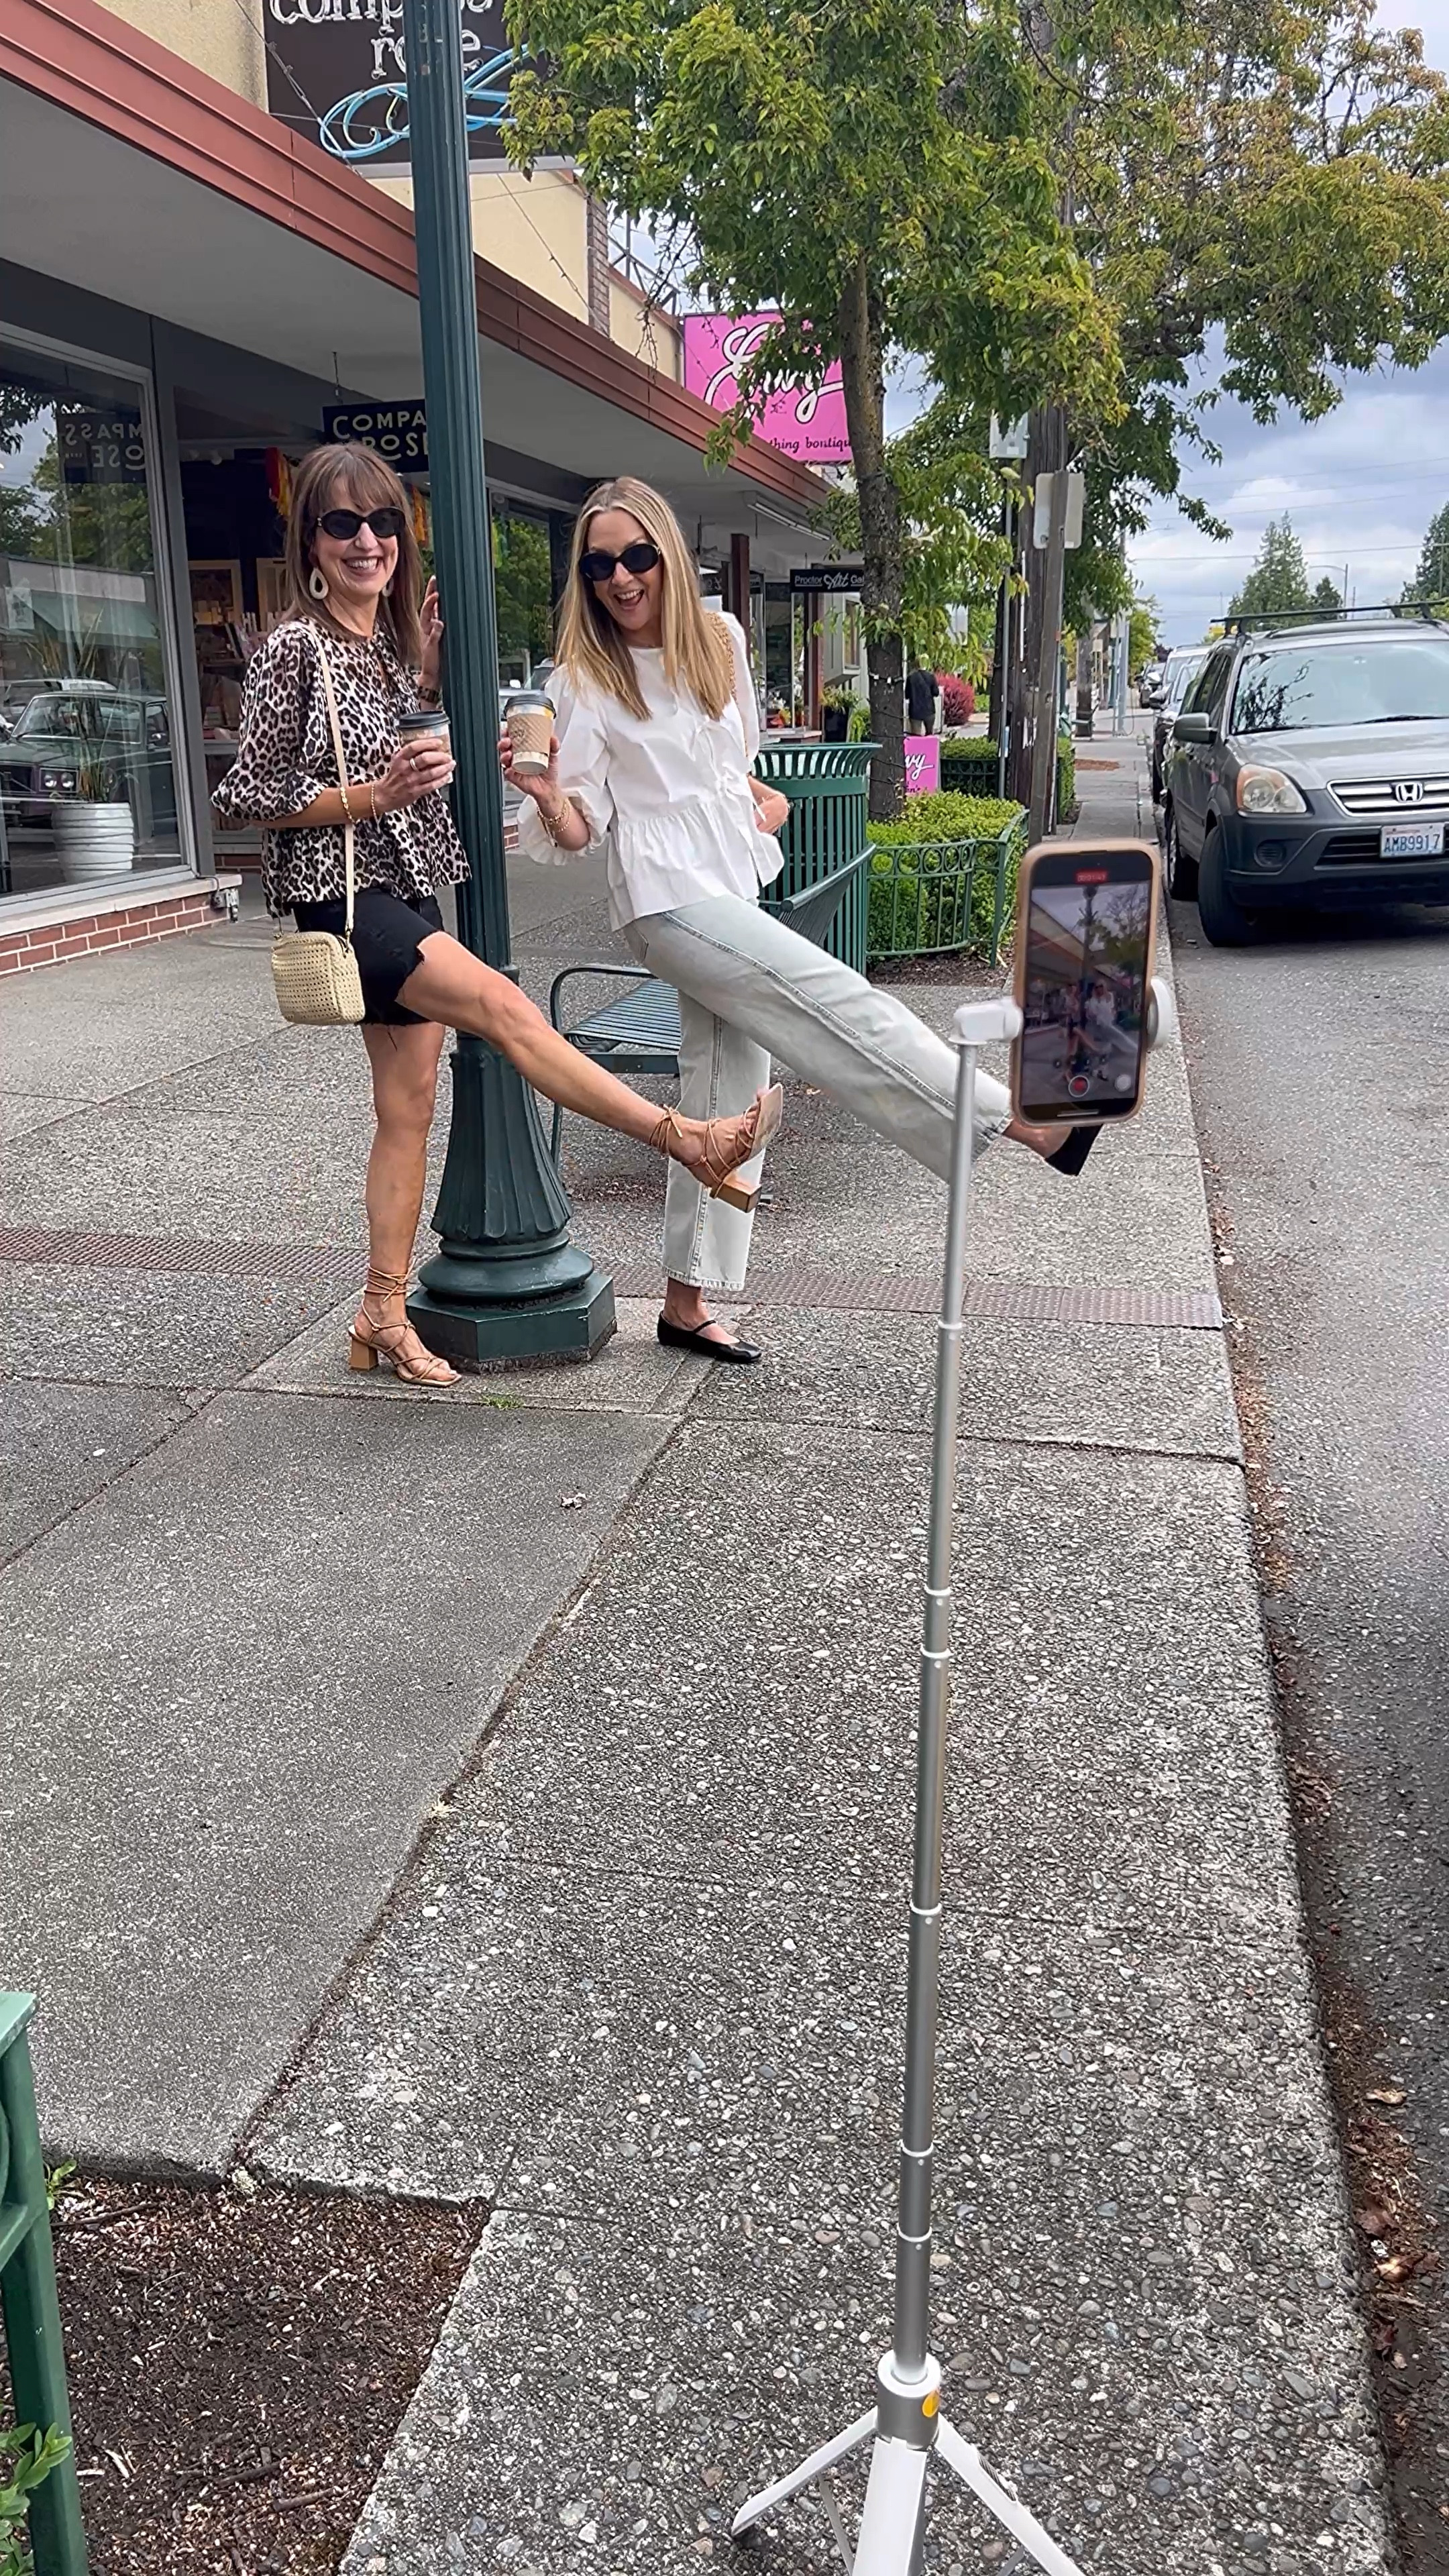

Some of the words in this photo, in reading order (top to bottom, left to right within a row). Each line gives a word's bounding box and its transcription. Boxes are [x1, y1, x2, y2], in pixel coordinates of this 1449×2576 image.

[269, 0, 492, 36] comp
[371, 30, 483, 79] re
[795, 575, 822, 585] Proctor
[823, 572, 849, 589] Art
[1384, 834, 1441, 853] AMB9917
